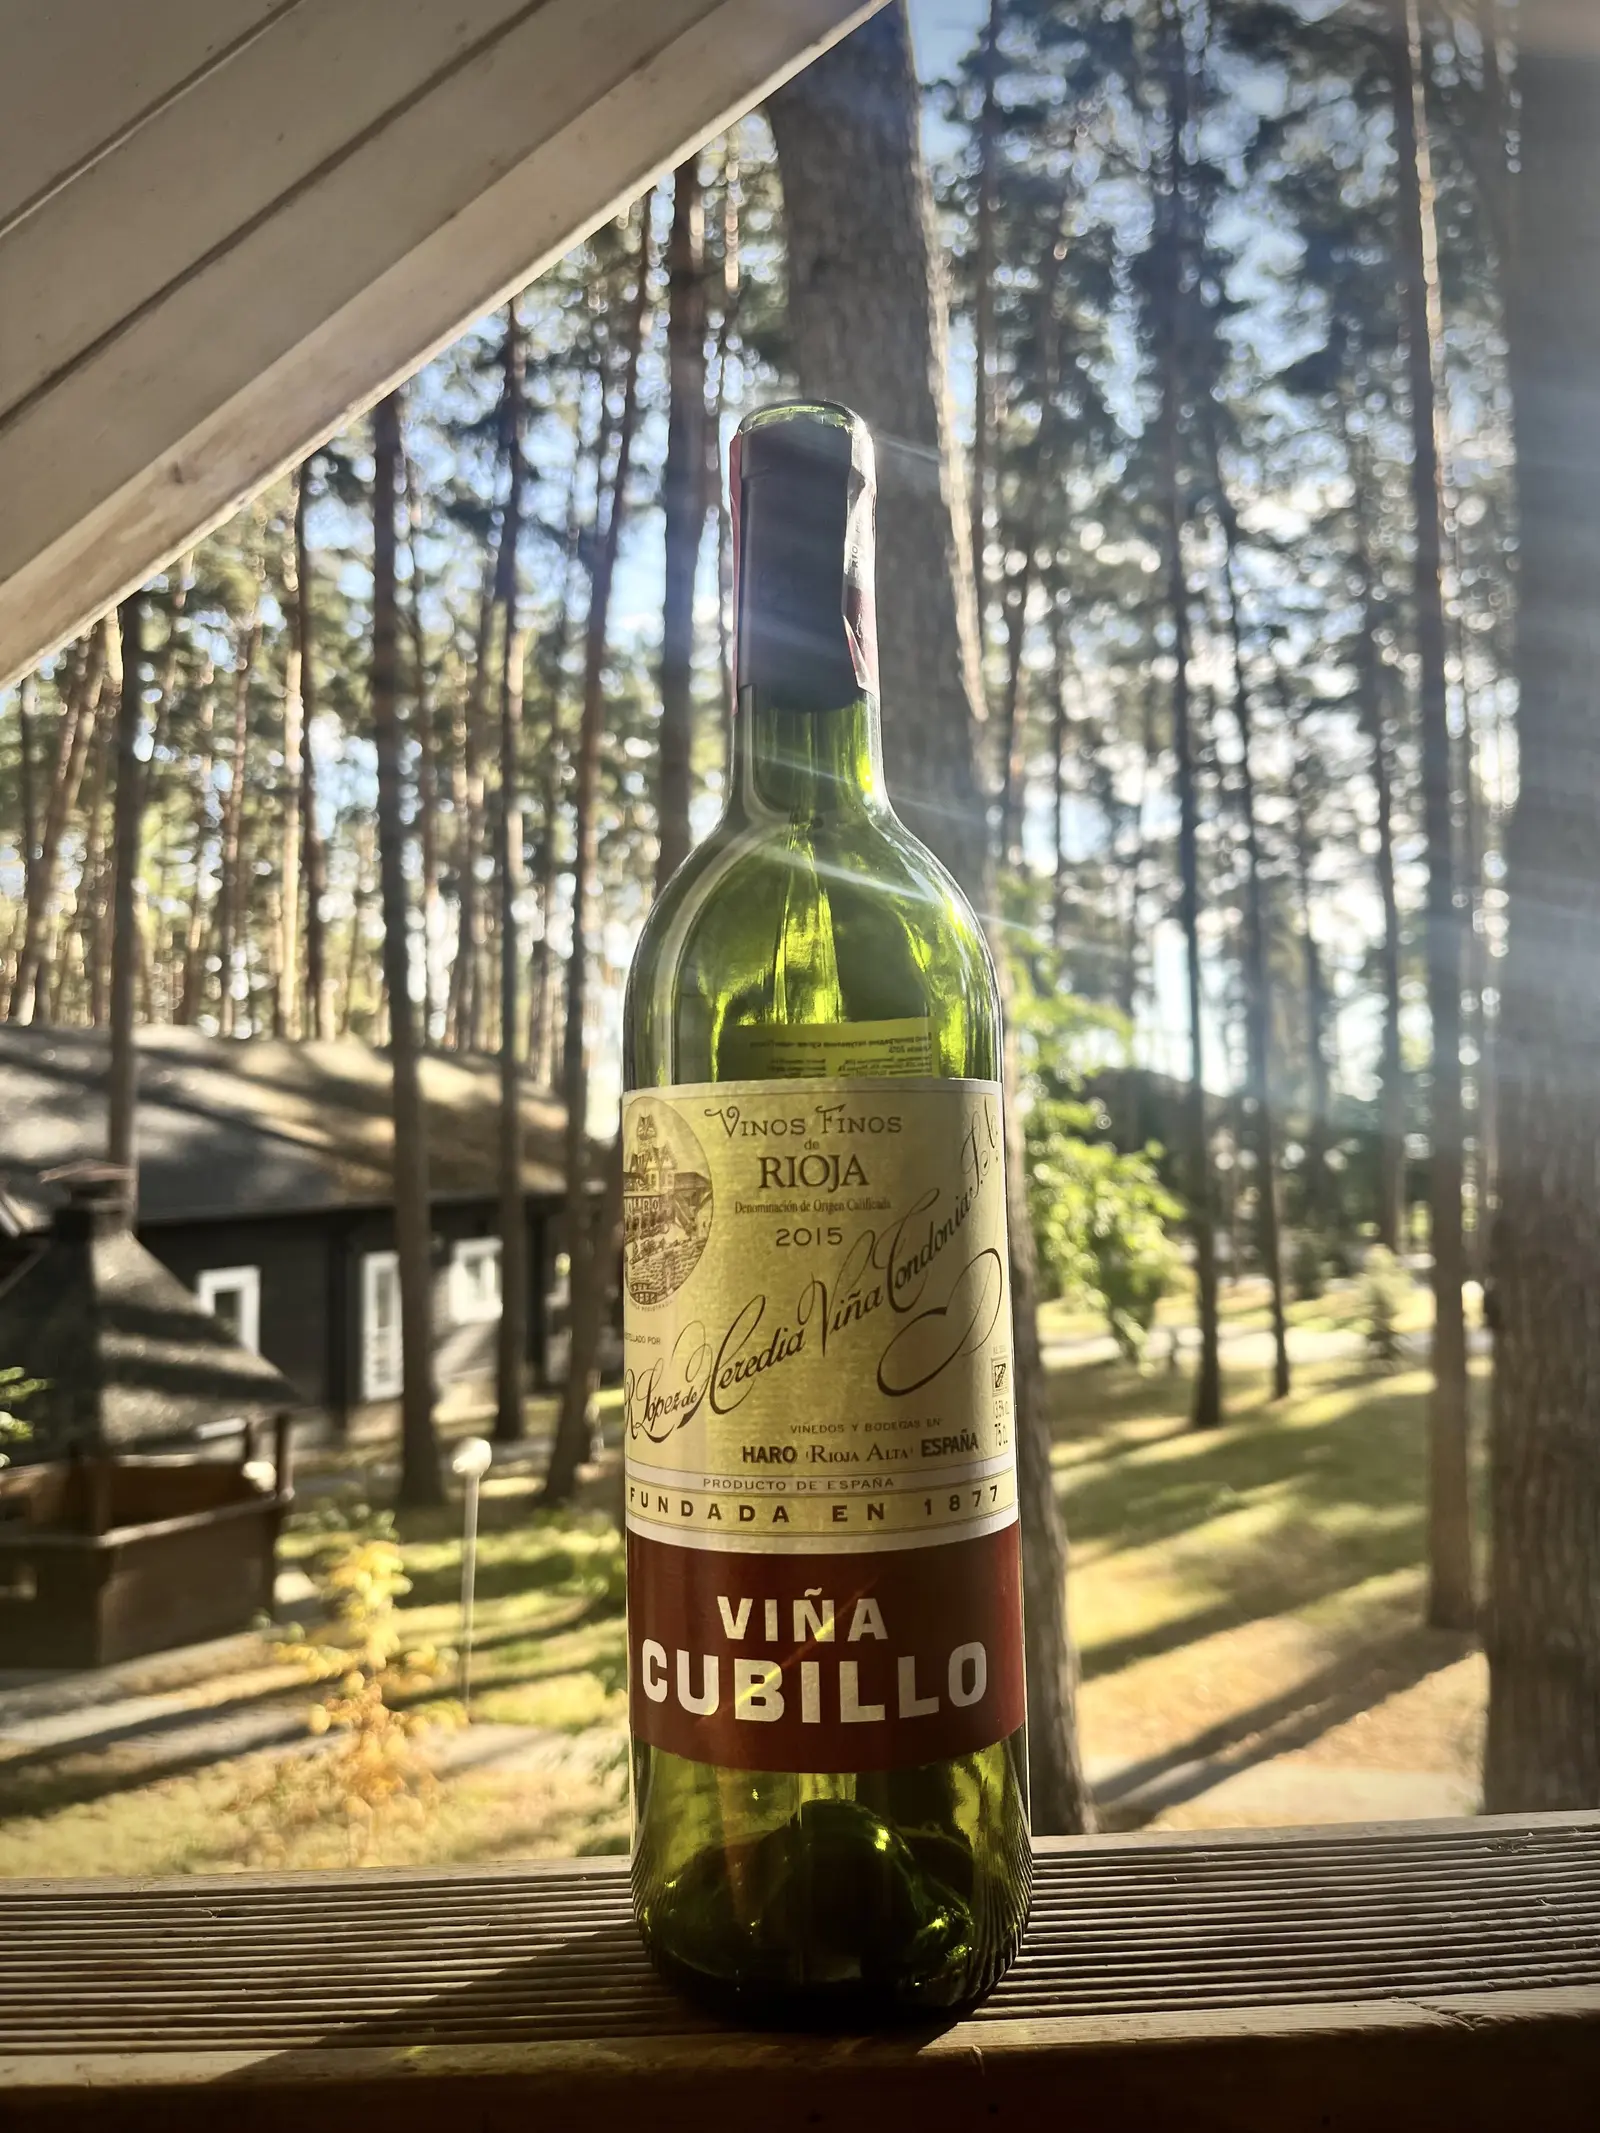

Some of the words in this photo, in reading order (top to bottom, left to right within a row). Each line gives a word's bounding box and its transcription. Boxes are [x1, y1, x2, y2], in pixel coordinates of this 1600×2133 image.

[704, 1106, 806, 1138] VINOS
[815, 1103, 903, 1135] FINOS
[803, 1138, 820, 1151] de
[758, 1154, 870, 1193] RIOJA
[734, 1199, 799, 1215] Denominación
[800, 1199, 811, 1212] de
[813, 1198, 845, 1215] Origen
[847, 1197, 892, 1212] Calificada
[776, 1226, 843, 1247] 2015
[681, 1385, 698, 1409] de
[798, 1229, 884, 1358] Viña
[647, 1336, 661, 1346] POR
[851, 1424, 859, 1433] Y
[864, 1420, 922, 1433] BODEGAS
[926, 1418, 941, 1428] EN
[742, 1445, 798, 1464] HARO
[921, 1428, 979, 1458] ESPAÑA
[703, 1478, 787, 1491] PRODUCTO
[796, 1480, 818, 1492] DE
[827, 1476, 894, 1490] ESPAÑA
[629, 1486, 790, 1523] FUNDADA
[832, 1503, 885, 1523] EN
[923, 1484, 998, 1516] 1877
[717, 1587, 889, 1643] VIÑA
[641, 1638, 988, 1724] CUBILLO
